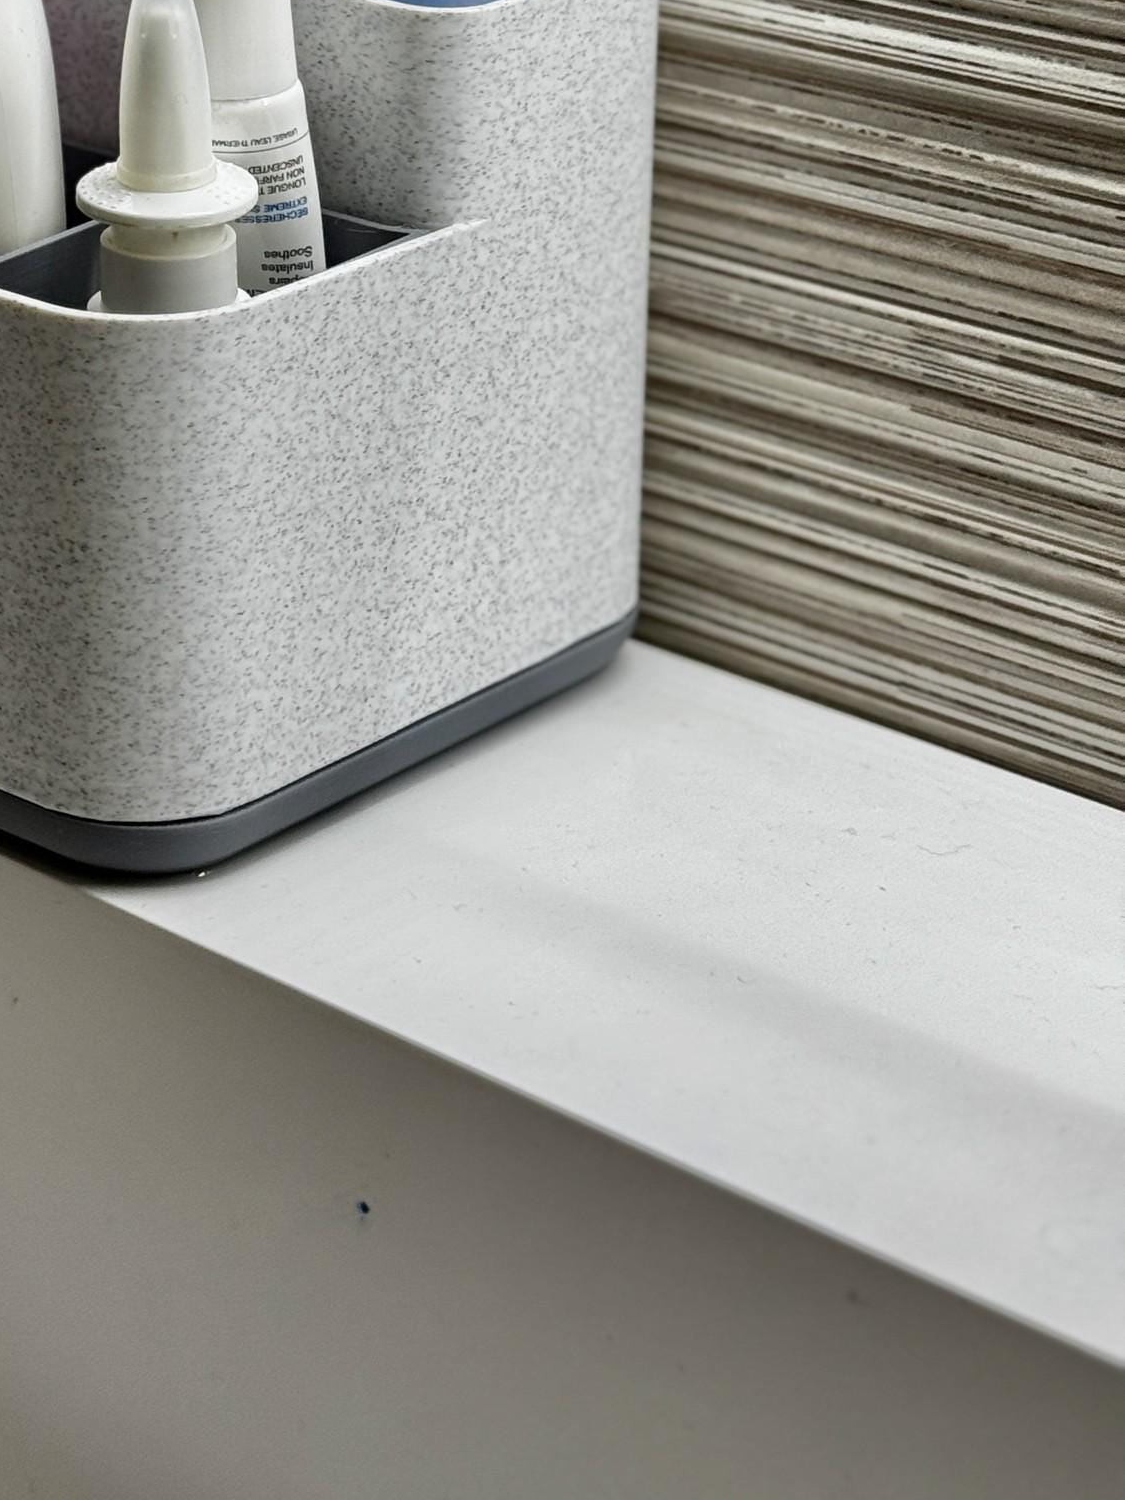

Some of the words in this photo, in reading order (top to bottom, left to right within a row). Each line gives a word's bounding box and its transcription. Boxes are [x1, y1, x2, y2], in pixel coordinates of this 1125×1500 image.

[248, 155, 303, 175] UNSCENTED
[286, 166, 305, 181] NON
[267, 177, 307, 195] LONGUE
[264, 246, 313, 261] Soothes
[261, 260, 314, 276] Insulates
